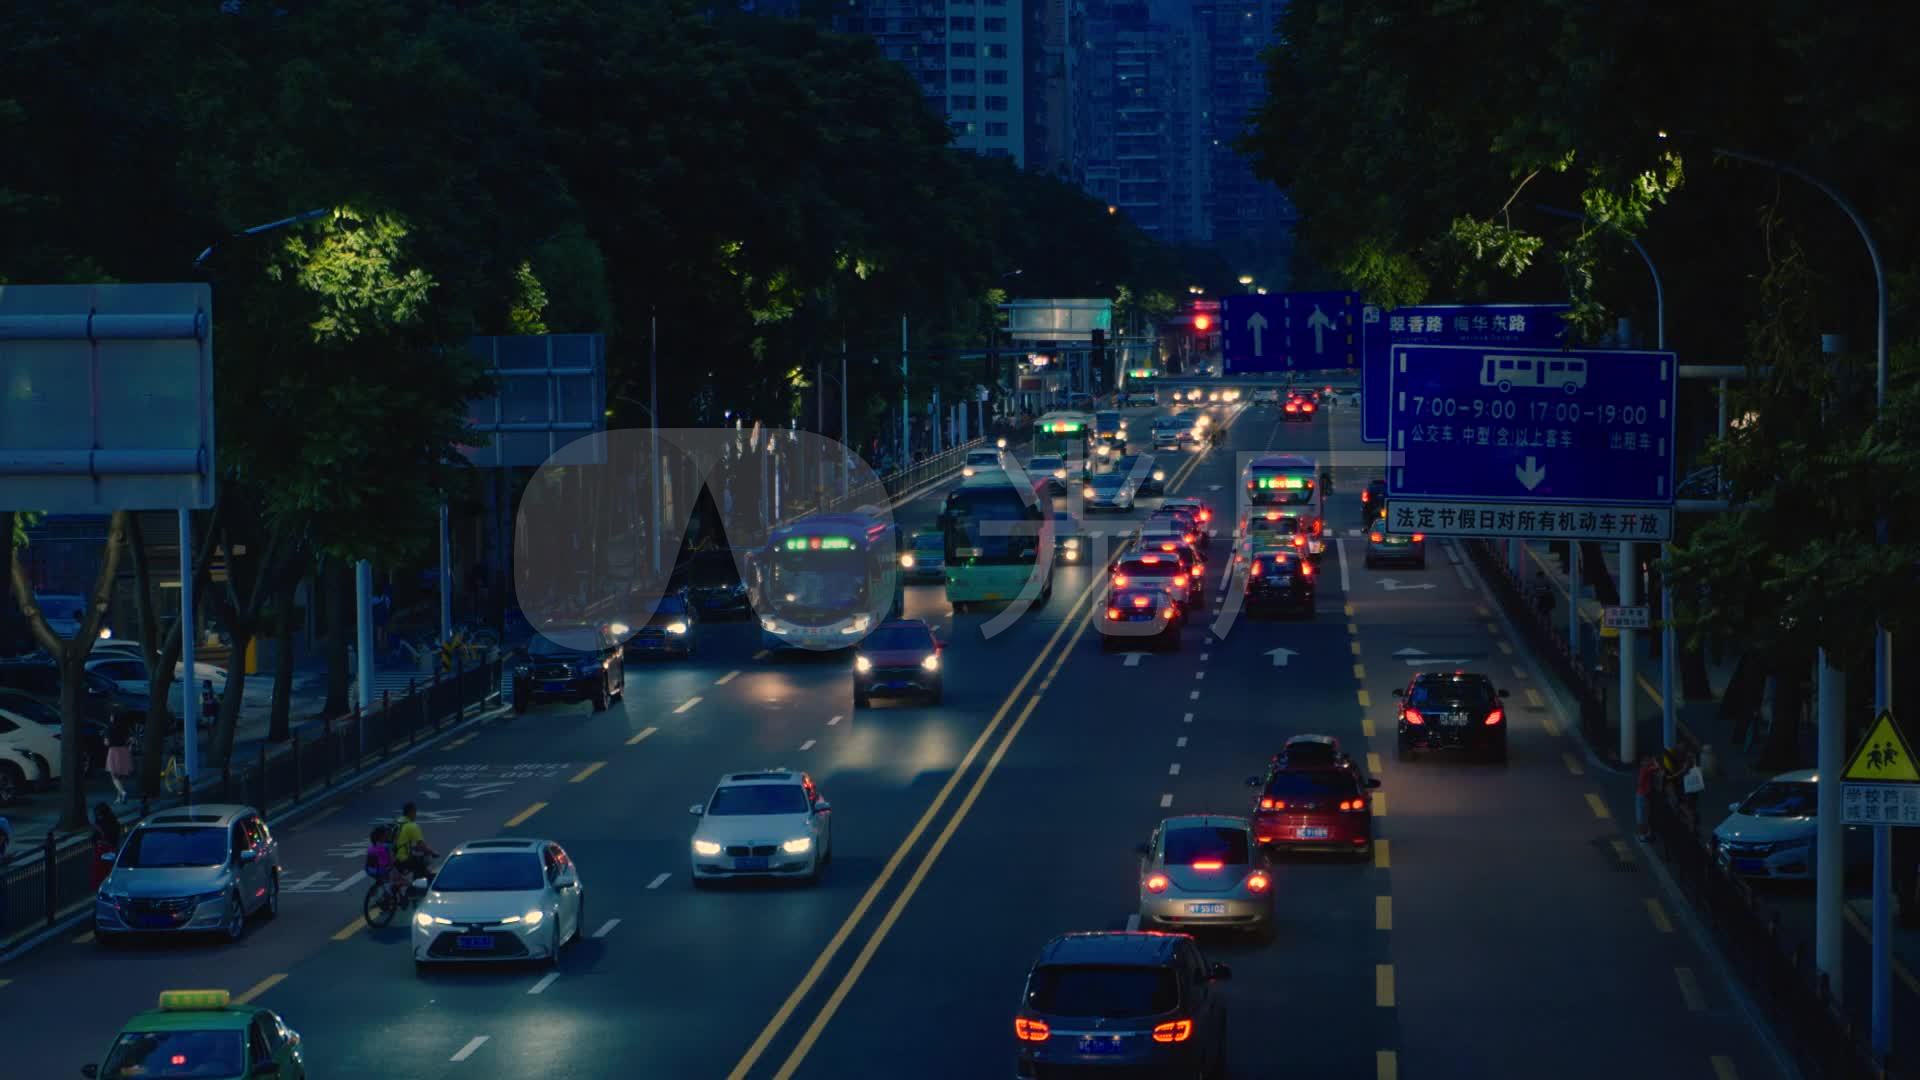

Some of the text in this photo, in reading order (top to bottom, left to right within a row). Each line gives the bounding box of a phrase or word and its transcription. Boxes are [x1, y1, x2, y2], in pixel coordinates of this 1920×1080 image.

[1413, 396, 1647, 425] 7:00-9:00 17:00-19:00
[1411, 423, 1454, 444] 公交车
[1610, 431, 1654, 451] 出租车
[1396, 507, 1660, 533] 法定节假日对所有机动车开放
